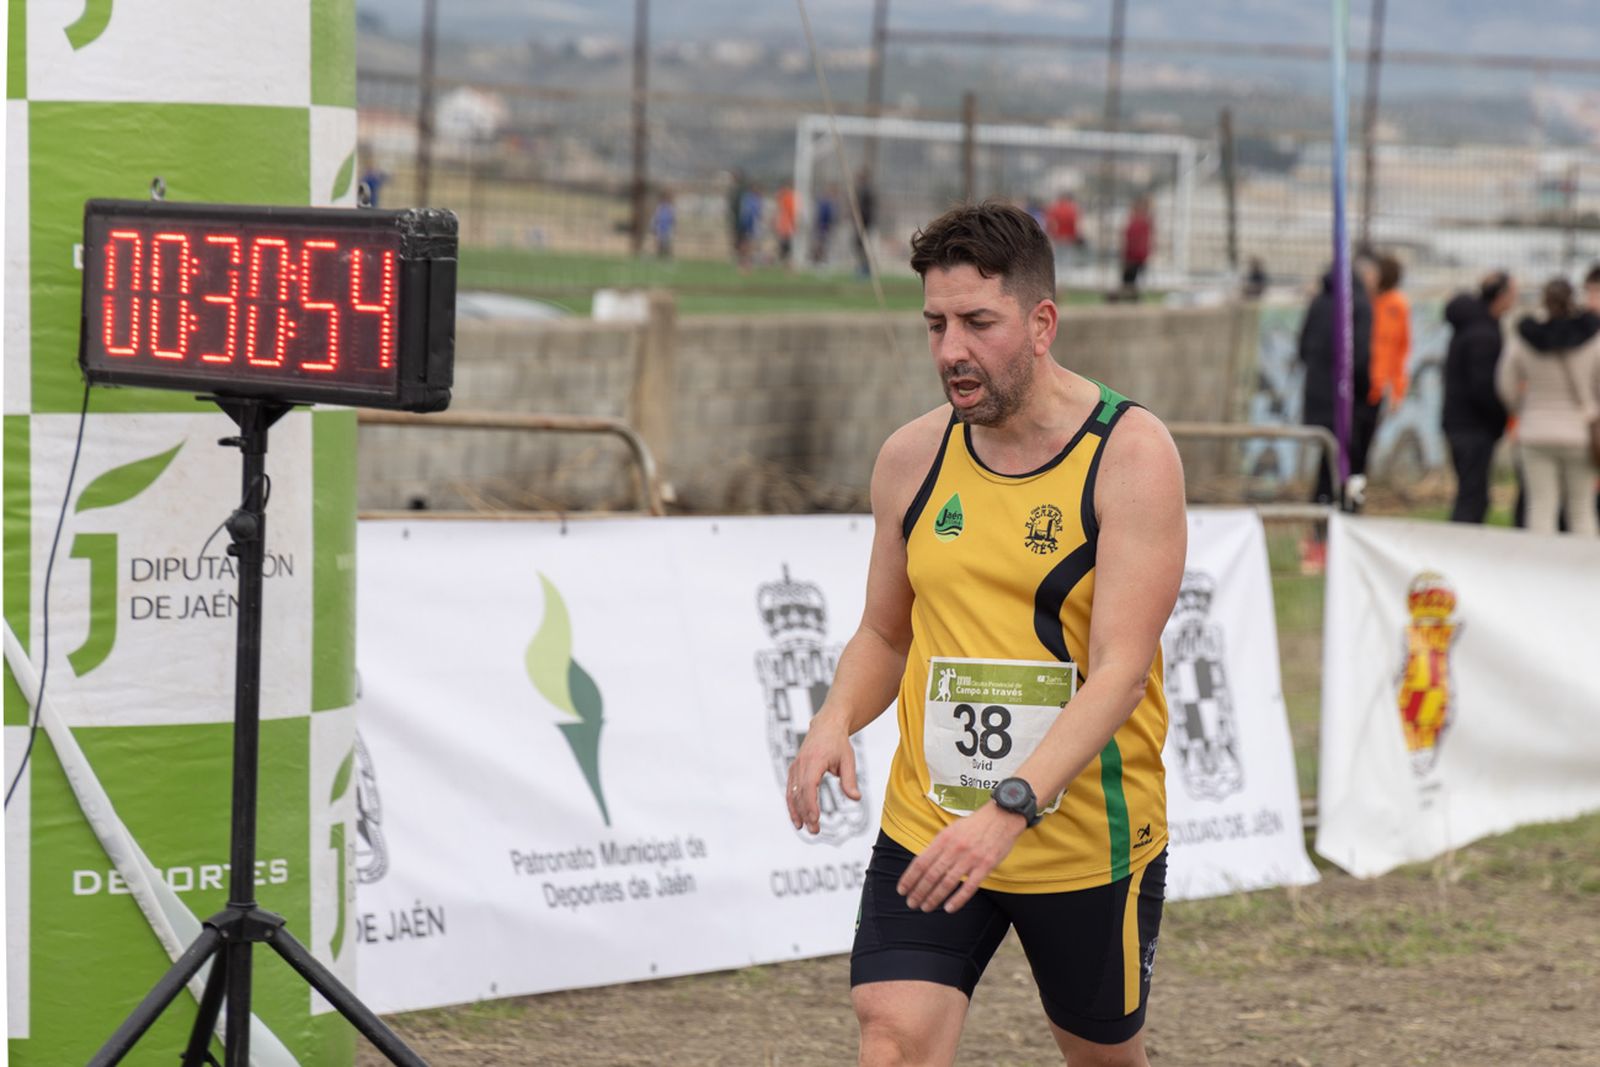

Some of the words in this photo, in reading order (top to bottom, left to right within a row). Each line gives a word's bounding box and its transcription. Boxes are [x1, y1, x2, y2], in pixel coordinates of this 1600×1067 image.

[103, 230, 394, 370] 00:30:54
[936, 509, 963, 527] Jaén
[131, 549, 294, 582] DIPUTAÓN
[131, 596, 171, 620] DE
[955, 686, 981, 697] Campo
[991, 687, 1023, 697] través
[953, 703, 1013, 760] 38
[510, 847, 596, 875] Patronato
[600, 835, 683, 867] Municipal
[687, 834, 706, 858] de
[73, 858, 288, 895] DEORES
[542, 880, 625, 912] Deportes
[628, 876, 651, 899] de
[656, 867, 697, 897] Jaén
[769, 864, 841, 898] CIUDAD
[385, 898, 445, 939] JAÉN
